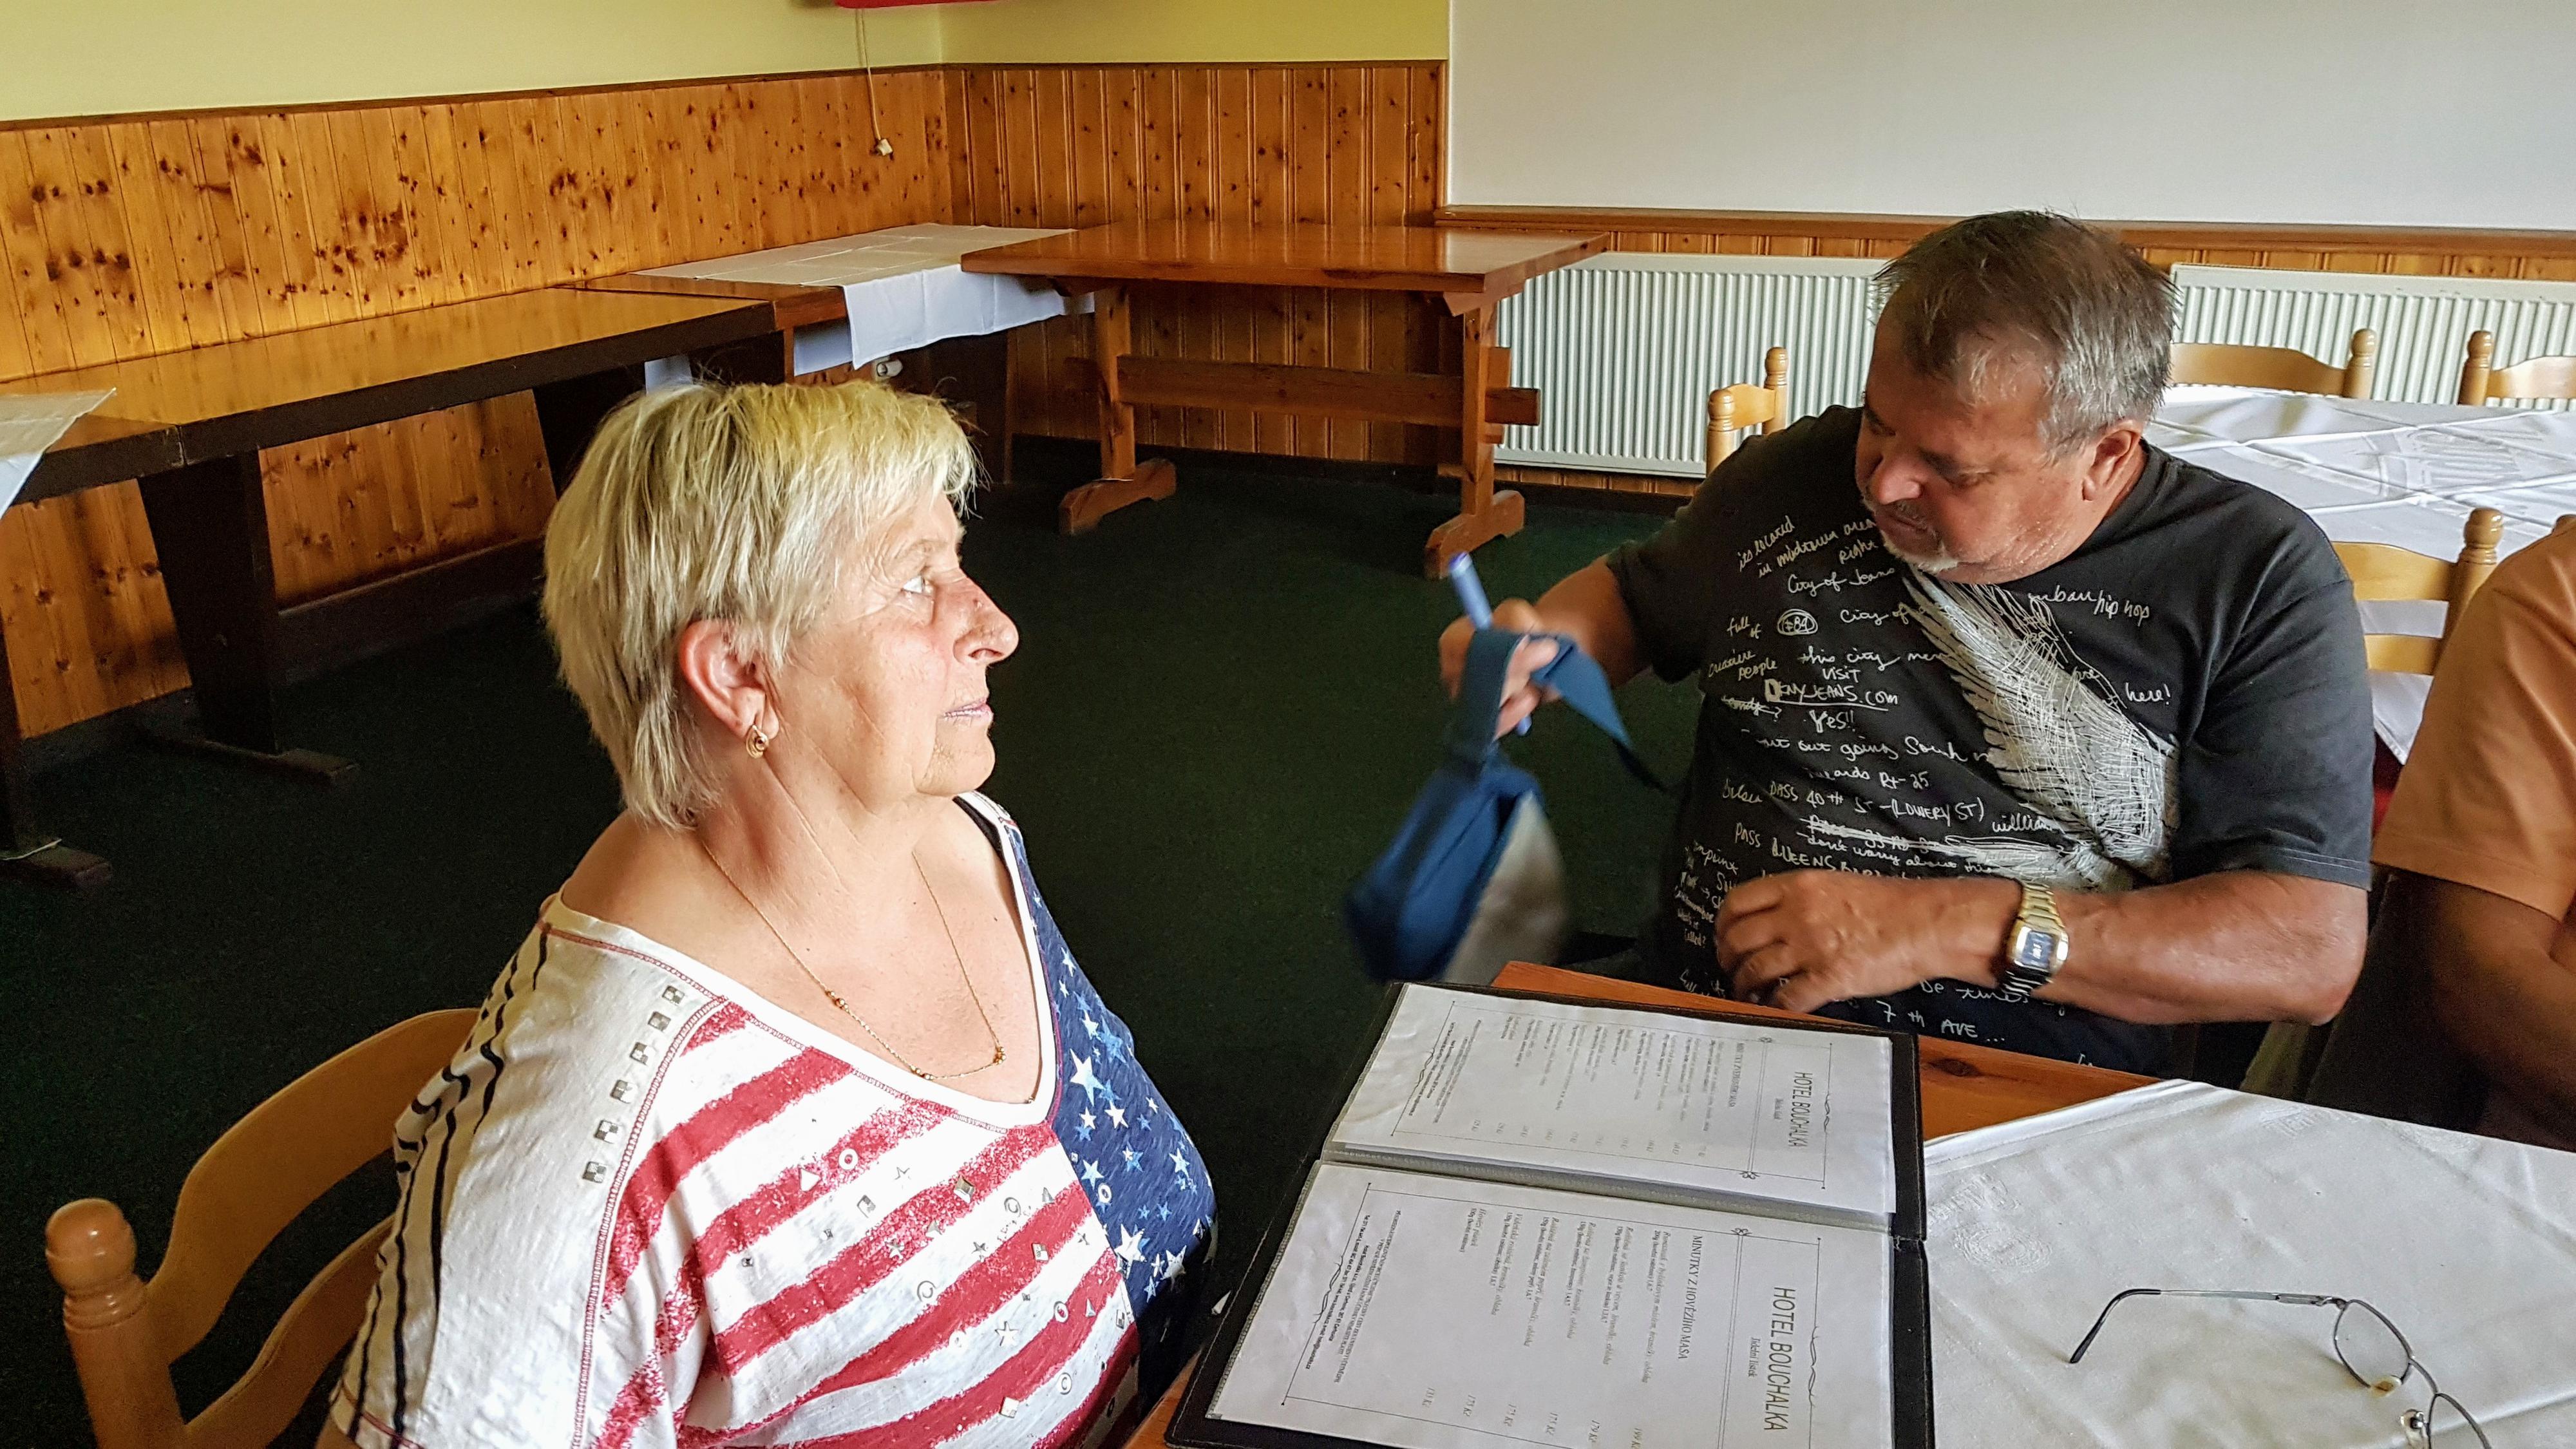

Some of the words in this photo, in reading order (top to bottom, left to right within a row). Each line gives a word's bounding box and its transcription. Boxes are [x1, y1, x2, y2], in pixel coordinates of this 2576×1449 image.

[1792, 1072, 1812, 1099] HOTEL
[1788, 1102, 1810, 1148] BOUCHALKA
[1688, 1235, 1702, 1277] MINUTKY
[1681, 1287, 1696, 1333] HOVĚZÍHO
[1770, 1287, 1795, 1338] HOTEL
[1763, 1342, 1792, 1431] BOUCHALKA
